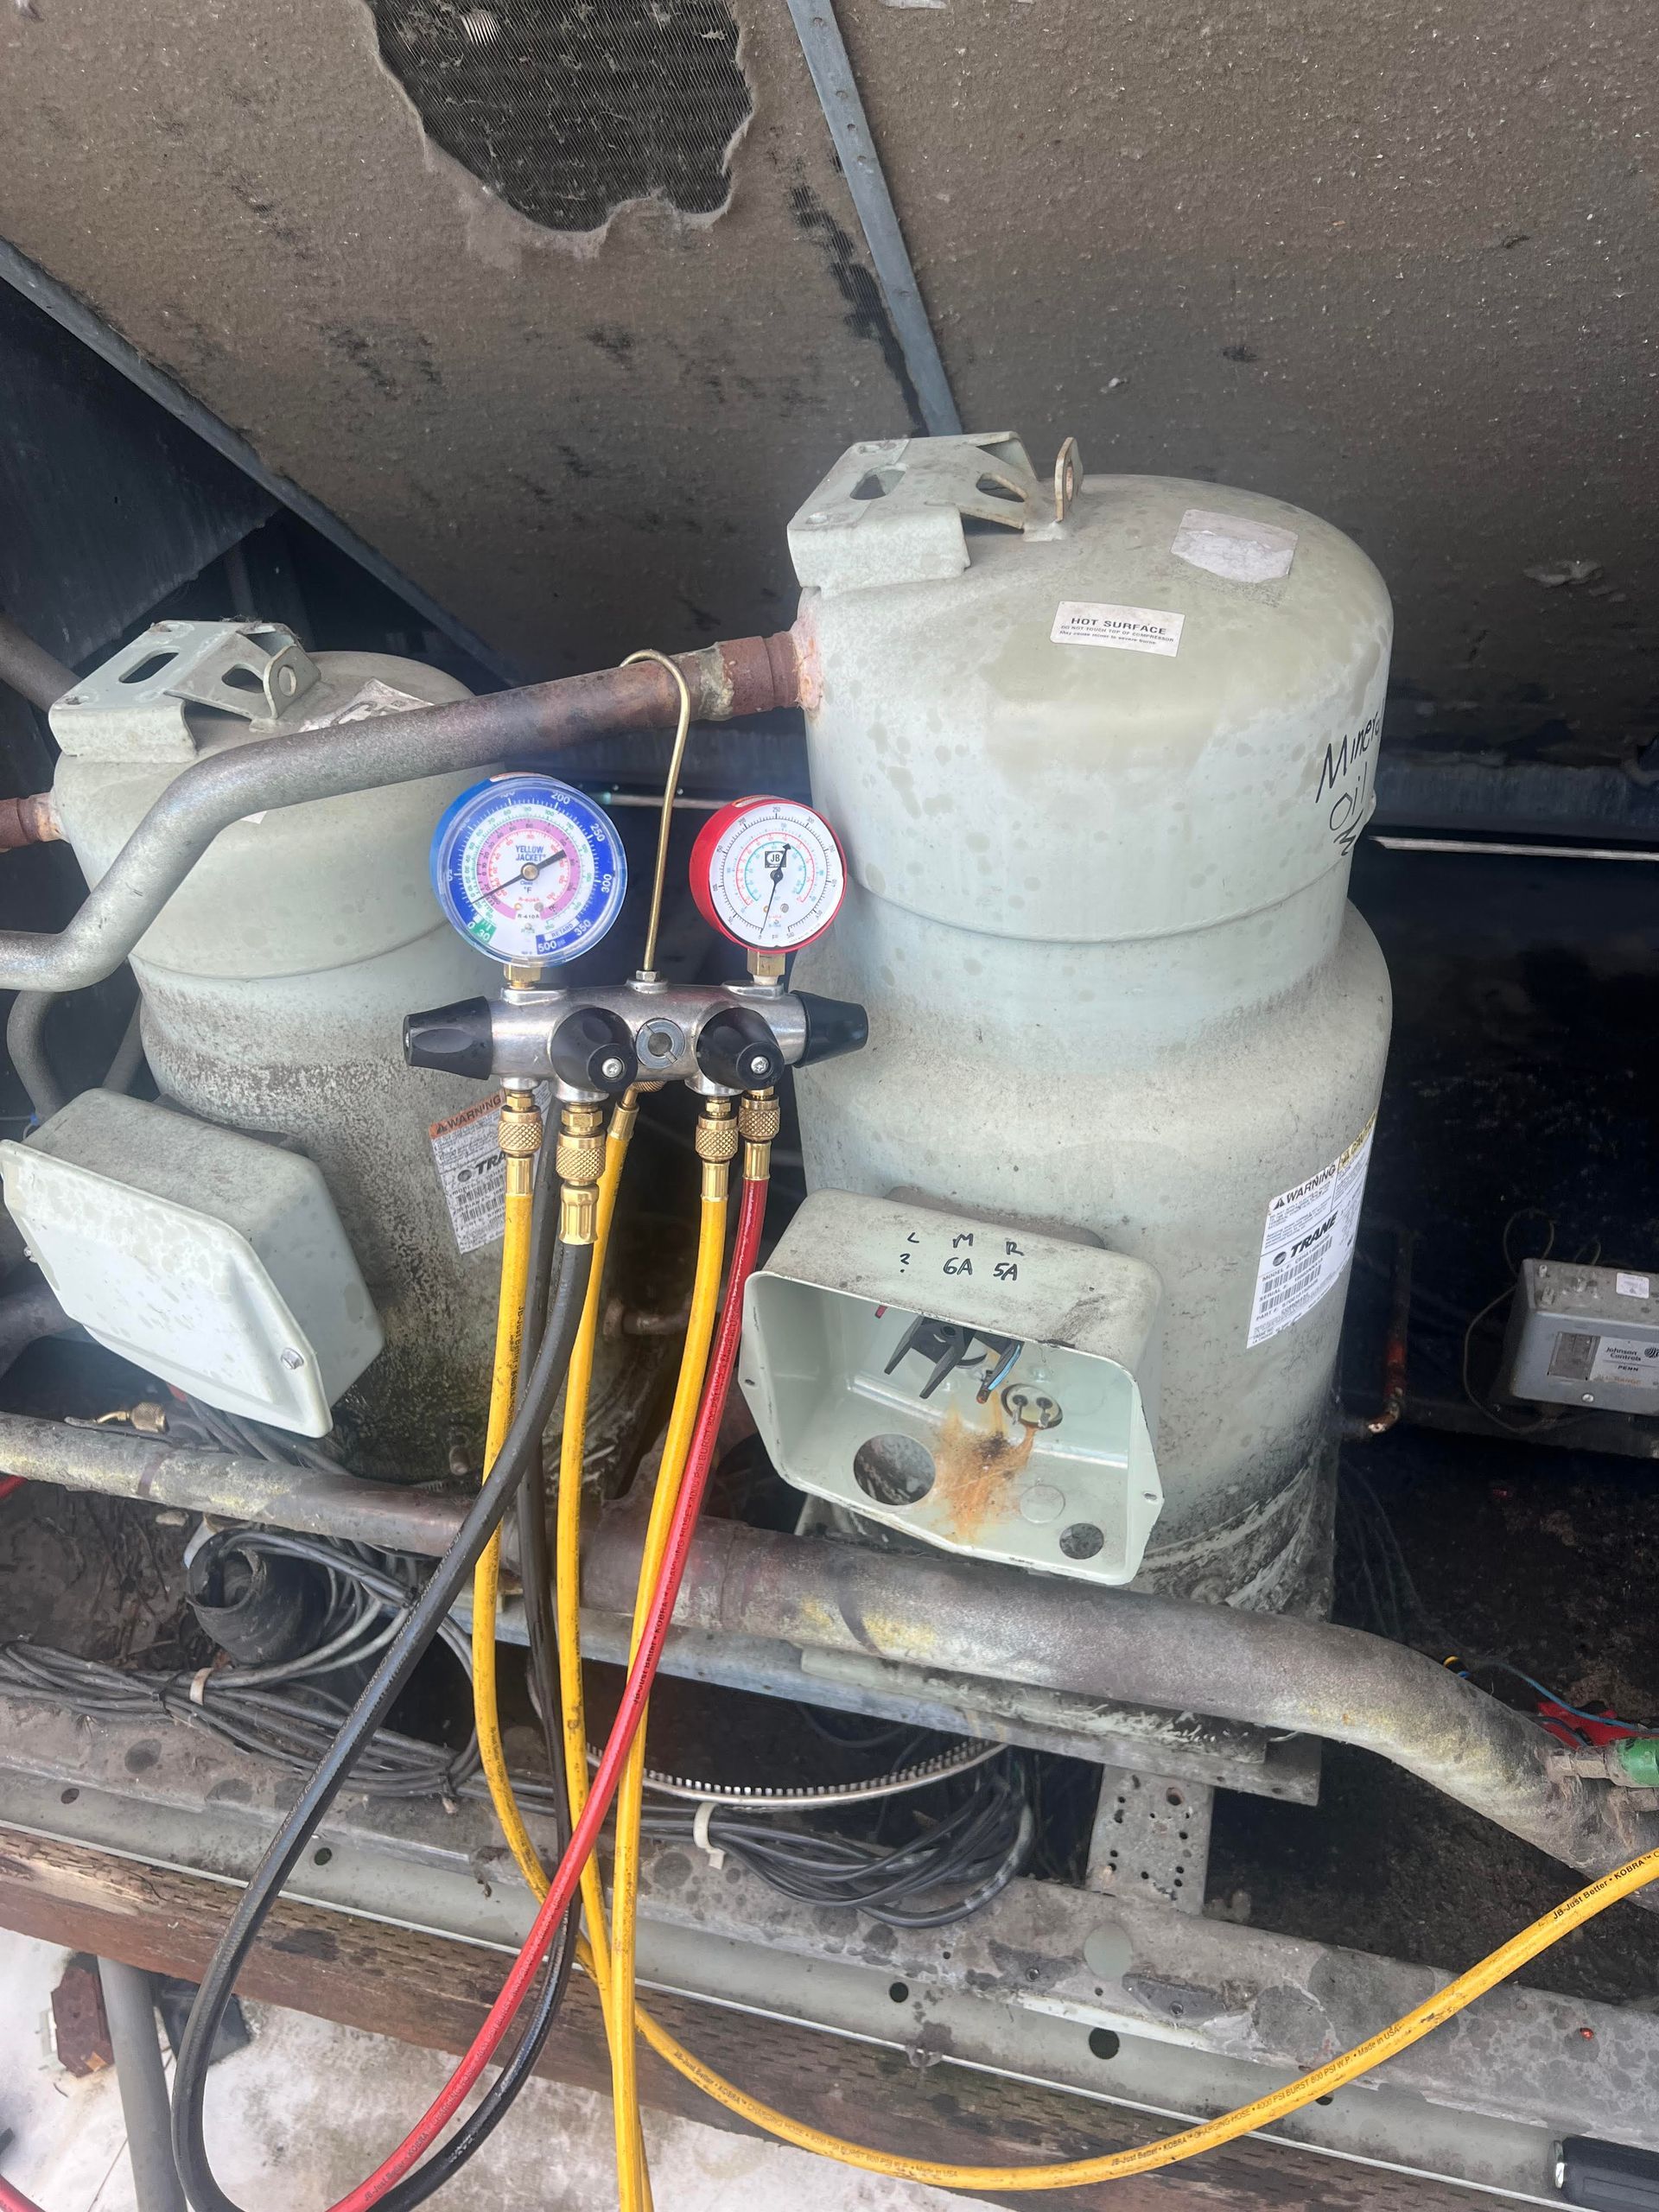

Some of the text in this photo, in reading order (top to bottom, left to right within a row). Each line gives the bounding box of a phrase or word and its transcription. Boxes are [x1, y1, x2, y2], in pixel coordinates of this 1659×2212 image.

[1103, 620, 1166, 634] SURFACE
[1132, 632, 1173, 642] COMPRESSOR
[551, 792, 570, 804] 200
[1329, 761, 1368, 831] Oil
[590, 823, 606, 842] 250
[770, 854, 780, 862] JB
[601, 874, 613, 893] 300
[467, 921, 476, 930] 0
[551, 923, 575, 938] RETARD
[574, 919, 592, 936] 350
[478, 929, 491, 941] 30
[537, 940, 557, 952] 500
[447, 1094, 501, 1128] WARNING
[475, 1150, 505, 1175] TRA
[1286, 1164, 1336, 1204] WARNING
[1290, 1211, 1338, 1258] TRANE
[907, 1232, 1025, 1256] L M R
[943, 1257, 973, 1275] 6A
[993, 1262, 1018, 1281] 5A
[1262, 1268, 1284, 1282] MODEL
[1260, 1288, 1281, 1302] SERIAL
[1255, 1310, 1272, 1321] PART
[1606, 1347, 1637, 1356] Johnson
[1610, 1352, 1641, 1362] Controls
[697, 1430, 712, 1462] BURST
[1553, 1897, 1584, 1920] JB-Just
[1583, 1879, 1609, 1899] Better
[1231, 2107, 1251, 2123] HOSE
[1256, 2098, 1272, 2110] 4000
[1273, 2093, 1285, 2104] PSI
[1286, 2080, 1309, 2097] BURST
[1311, 2071, 1324, 2084] 800
[1324, 2063, 1337, 2079] PSI
[1337, 2056, 1353, 2069] W.P.
[1357, 2041, 1376, 2056] Made
[433, 2086, 462, 2127] CHARGING
